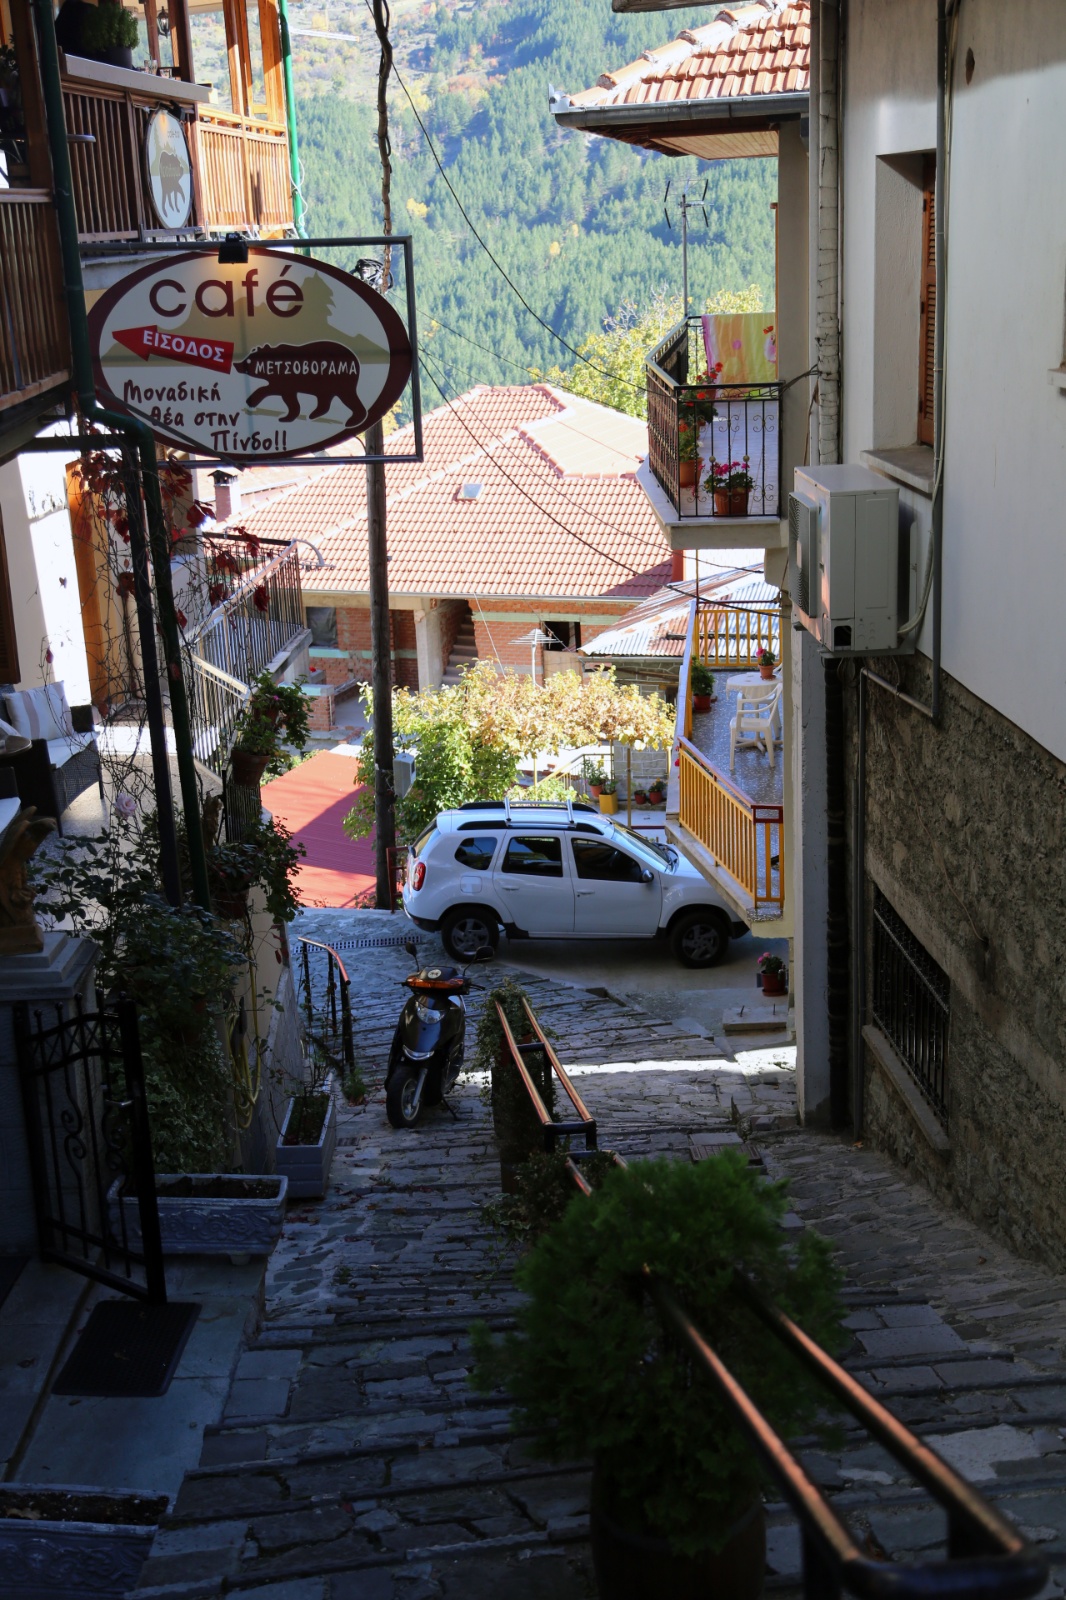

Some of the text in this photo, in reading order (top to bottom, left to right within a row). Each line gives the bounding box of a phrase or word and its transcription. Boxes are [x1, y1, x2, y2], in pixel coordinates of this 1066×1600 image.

[149, 264, 304, 318] café
[143, 329, 225, 363] ΕΙΣΟΔΟΣ
[254, 360, 358, 376] ΜΕΤΣΟΒΟΡΑΜΑ
[123, 379, 221, 404] Μοναδική
[150, 405, 240, 427] θέα στην
[210, 429, 288, 452] Πίνδο!!
